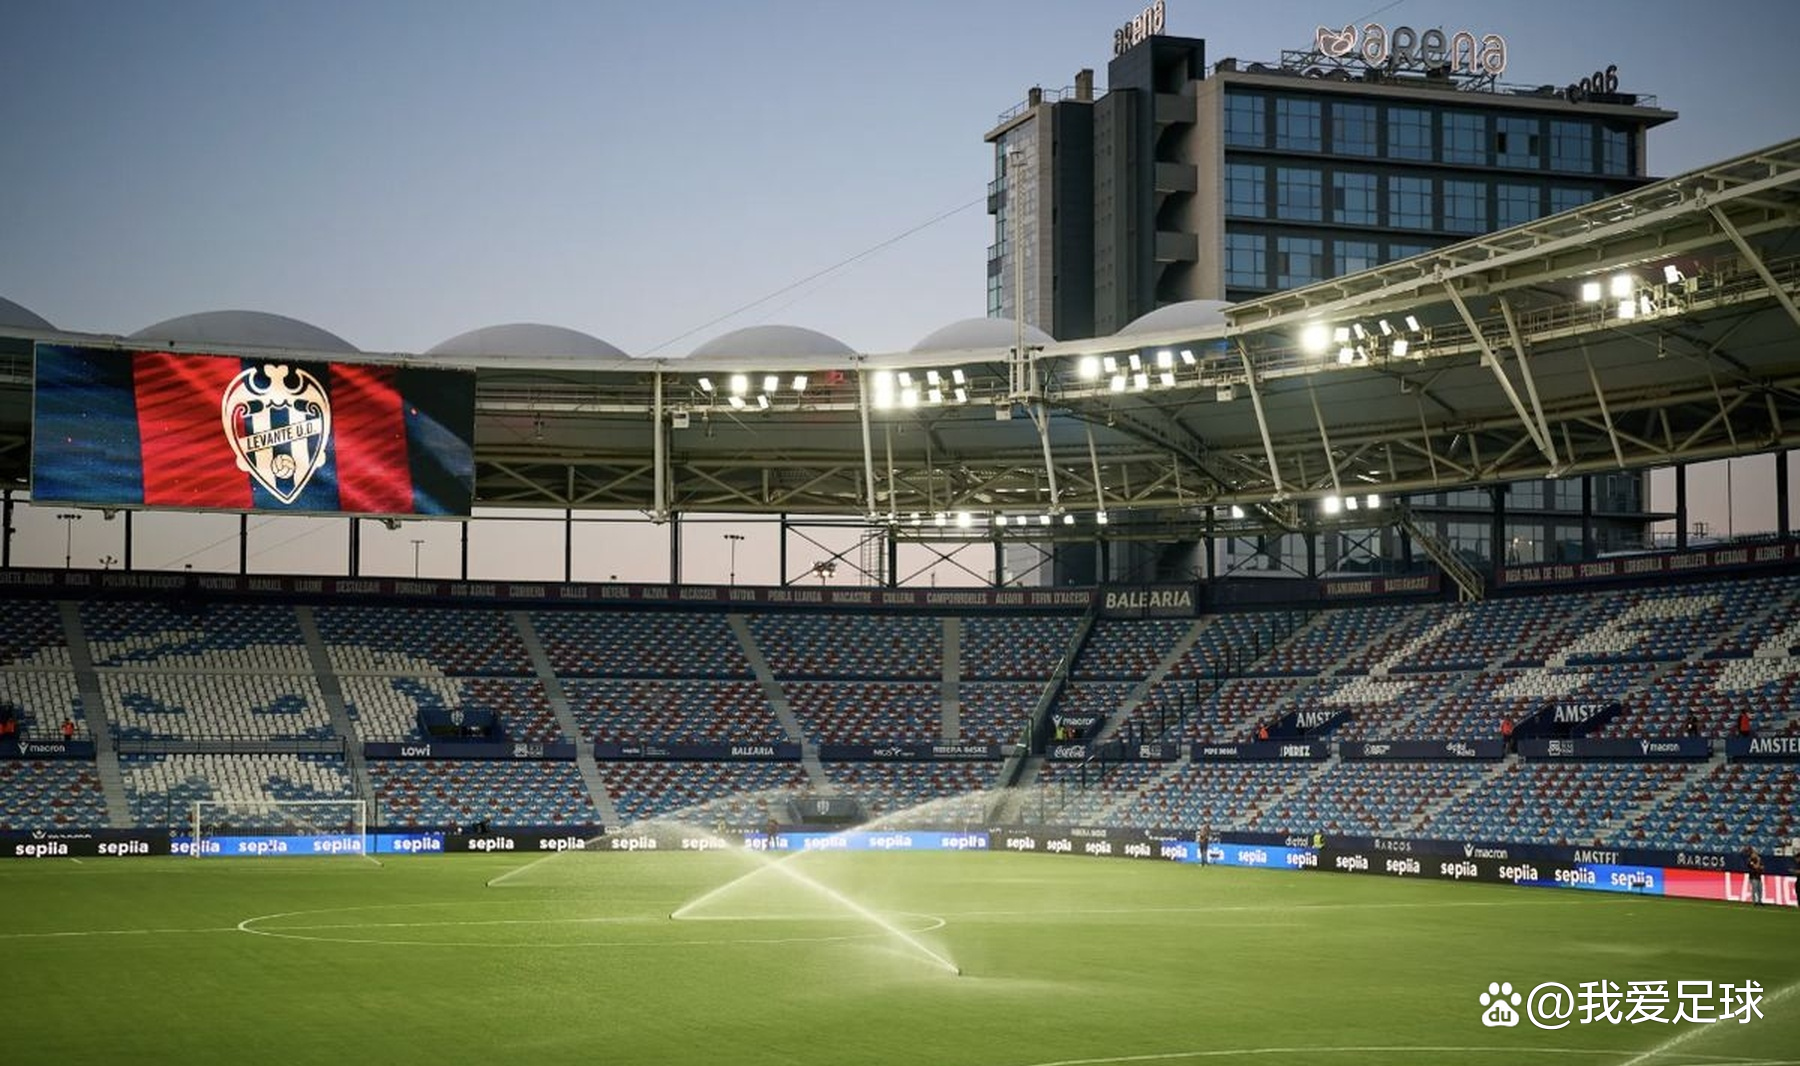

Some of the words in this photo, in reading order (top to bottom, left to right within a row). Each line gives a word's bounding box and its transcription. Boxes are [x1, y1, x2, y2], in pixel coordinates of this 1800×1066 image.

[246, 427, 292, 450] LEVANTE
[1295, 710, 1343, 728] AMST
[1553, 704, 1611, 723] AMST
[29, 745, 66, 753] macron
[1649, 743, 1681, 753] macron
[15, 842, 69, 858] sepiia
[98, 840, 149, 856] sepiia
[313, 837, 362, 853] sepiia
[393, 837, 440, 852] sepiia
[468, 837, 515, 852] sepiia
[539, 837, 586, 852] sepiia
[611, 837, 657, 851] sepiia
[1286, 852, 1318, 868] sepiia
[1474, 847, 1508, 859] macron
[1335, 854, 1369, 872] sepiia
[1386, 858, 1421, 876] sepiia
[1440, 861, 1478, 879] sepiia
[1499, 864, 1538, 884] sepiia
[1555, 868, 1595, 886] sepiia
[1611, 872, 1654, 892] sepiia
